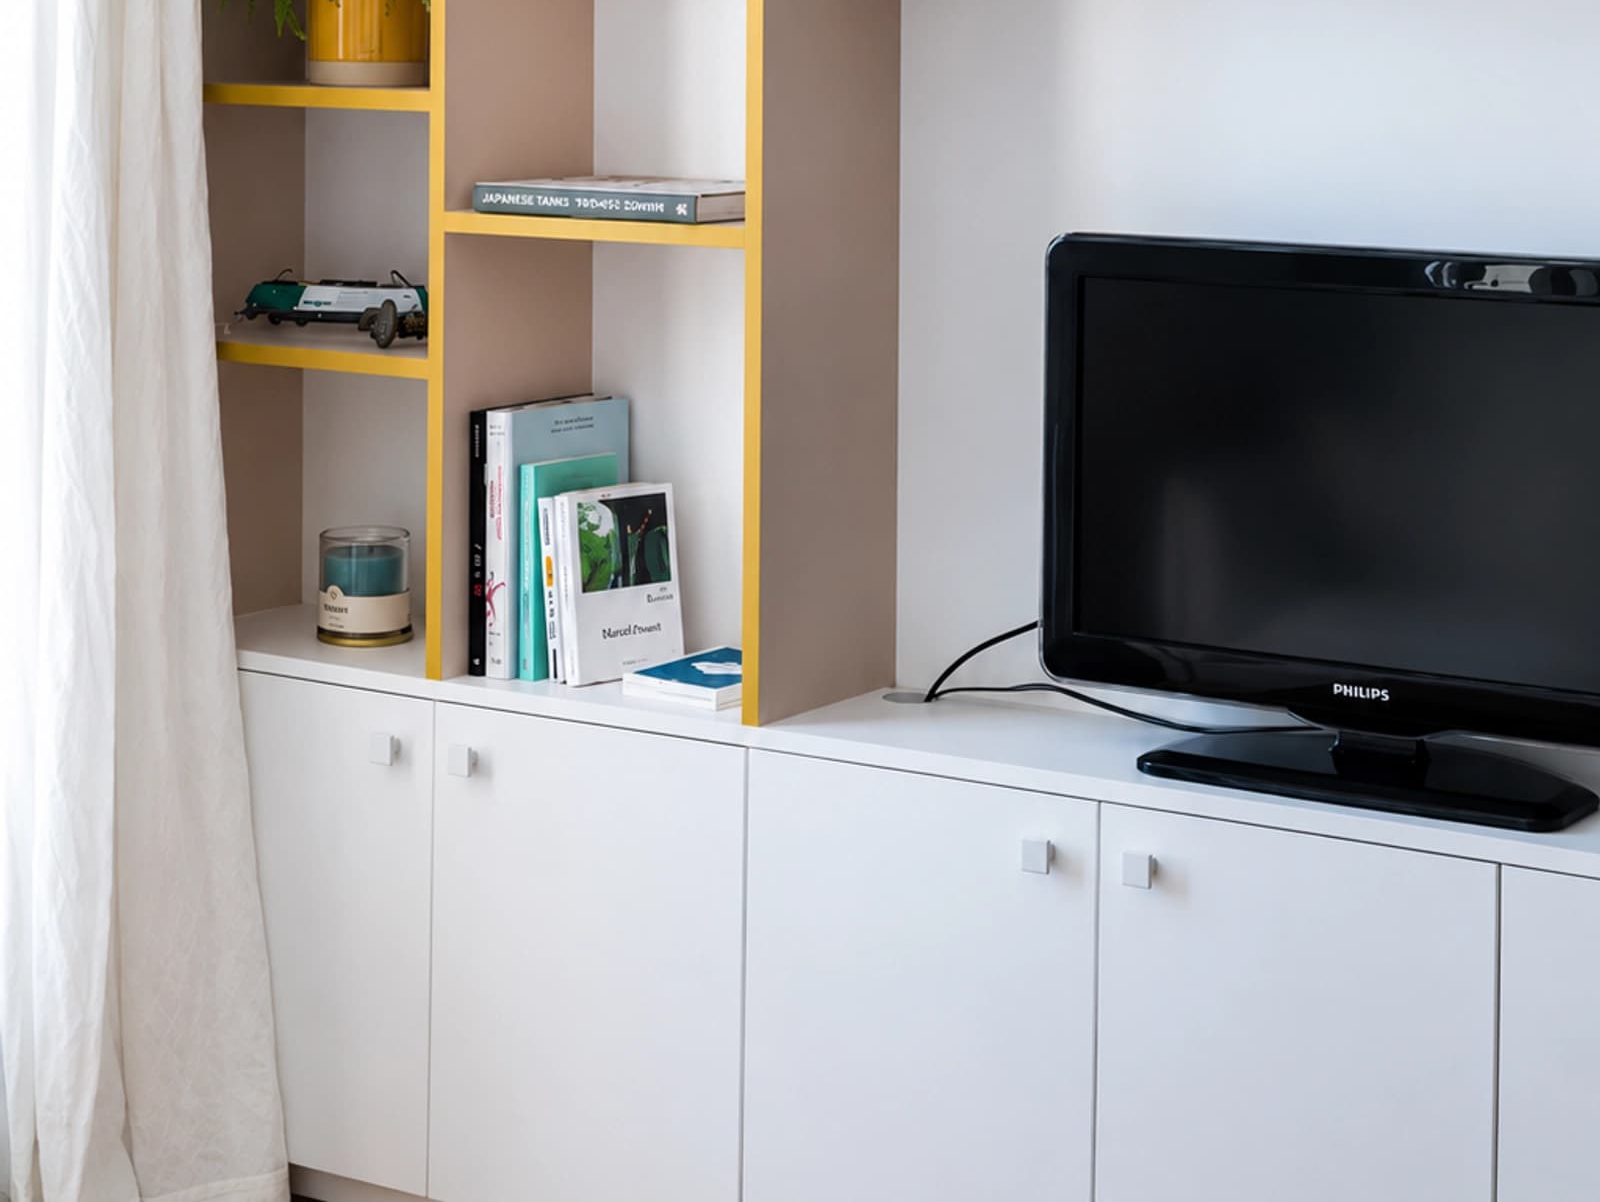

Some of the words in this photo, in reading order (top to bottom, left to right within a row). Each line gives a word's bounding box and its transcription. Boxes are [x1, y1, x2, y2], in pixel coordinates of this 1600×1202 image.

[482, 193, 534, 205] JAPANESE
[536, 195, 569, 207] TANKS
[1333, 682, 1390, 701] PHILIPS
